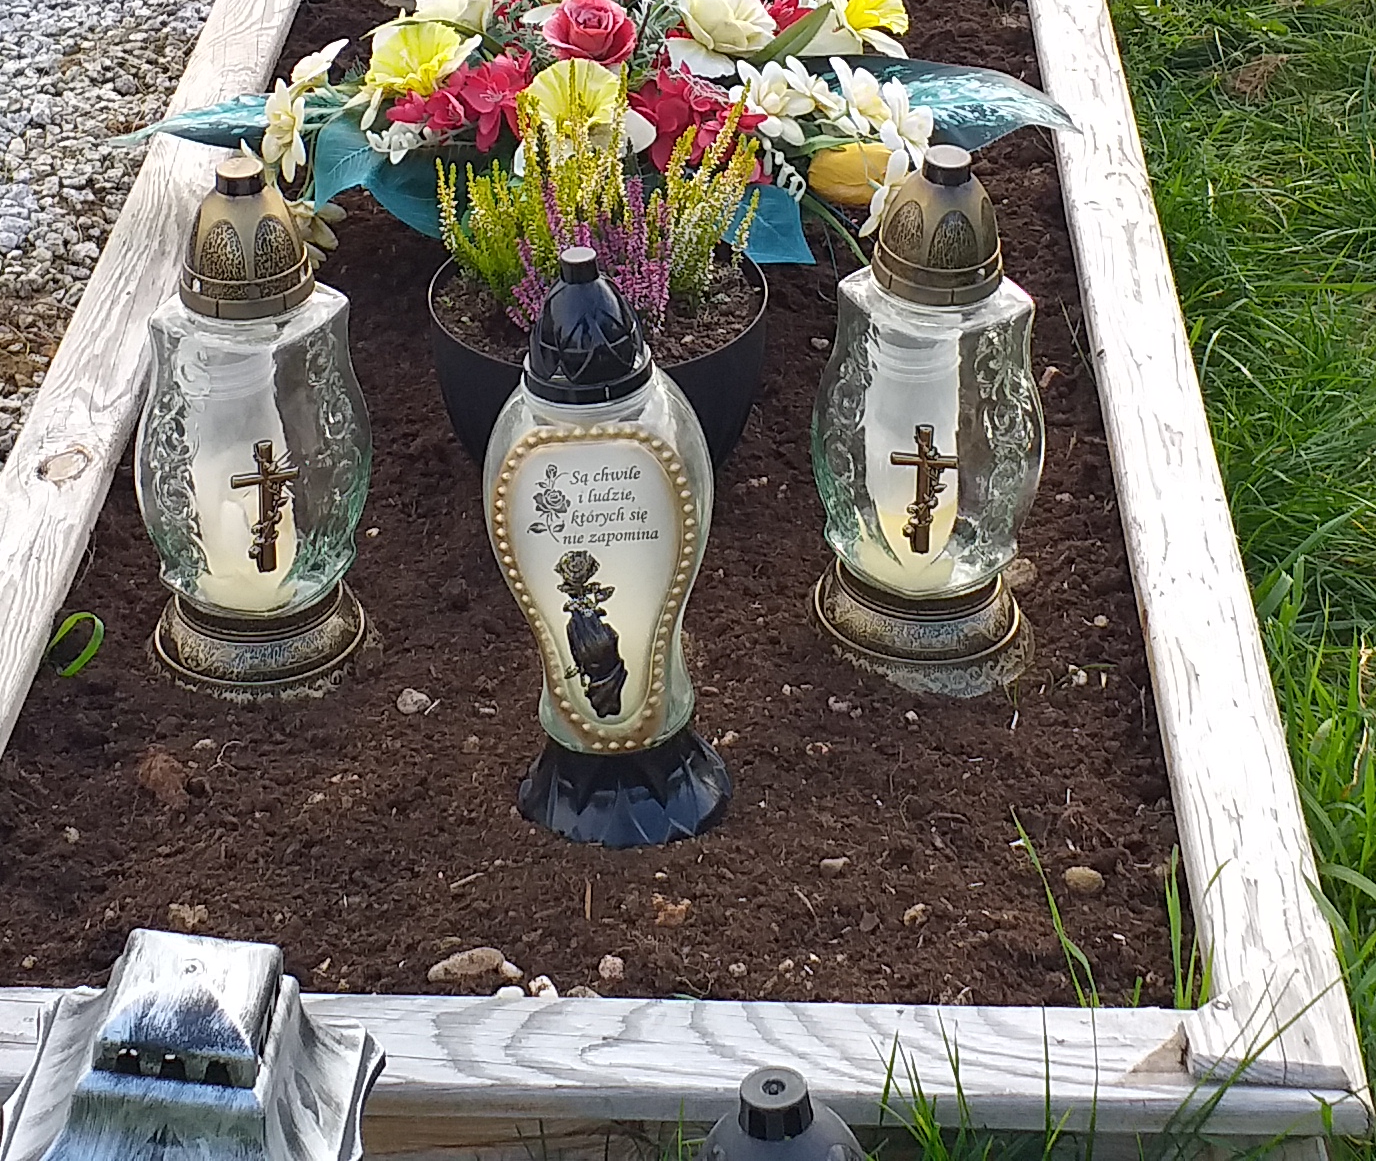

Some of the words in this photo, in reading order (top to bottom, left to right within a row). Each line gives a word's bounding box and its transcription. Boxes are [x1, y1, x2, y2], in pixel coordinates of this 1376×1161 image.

[569, 470, 589, 485] Są
[593, 465, 642, 482] chwile
[570, 507, 625, 528] których
[629, 506, 649, 523] się
[562, 532, 584, 546] nie
[587, 527, 660, 547] zapomina
